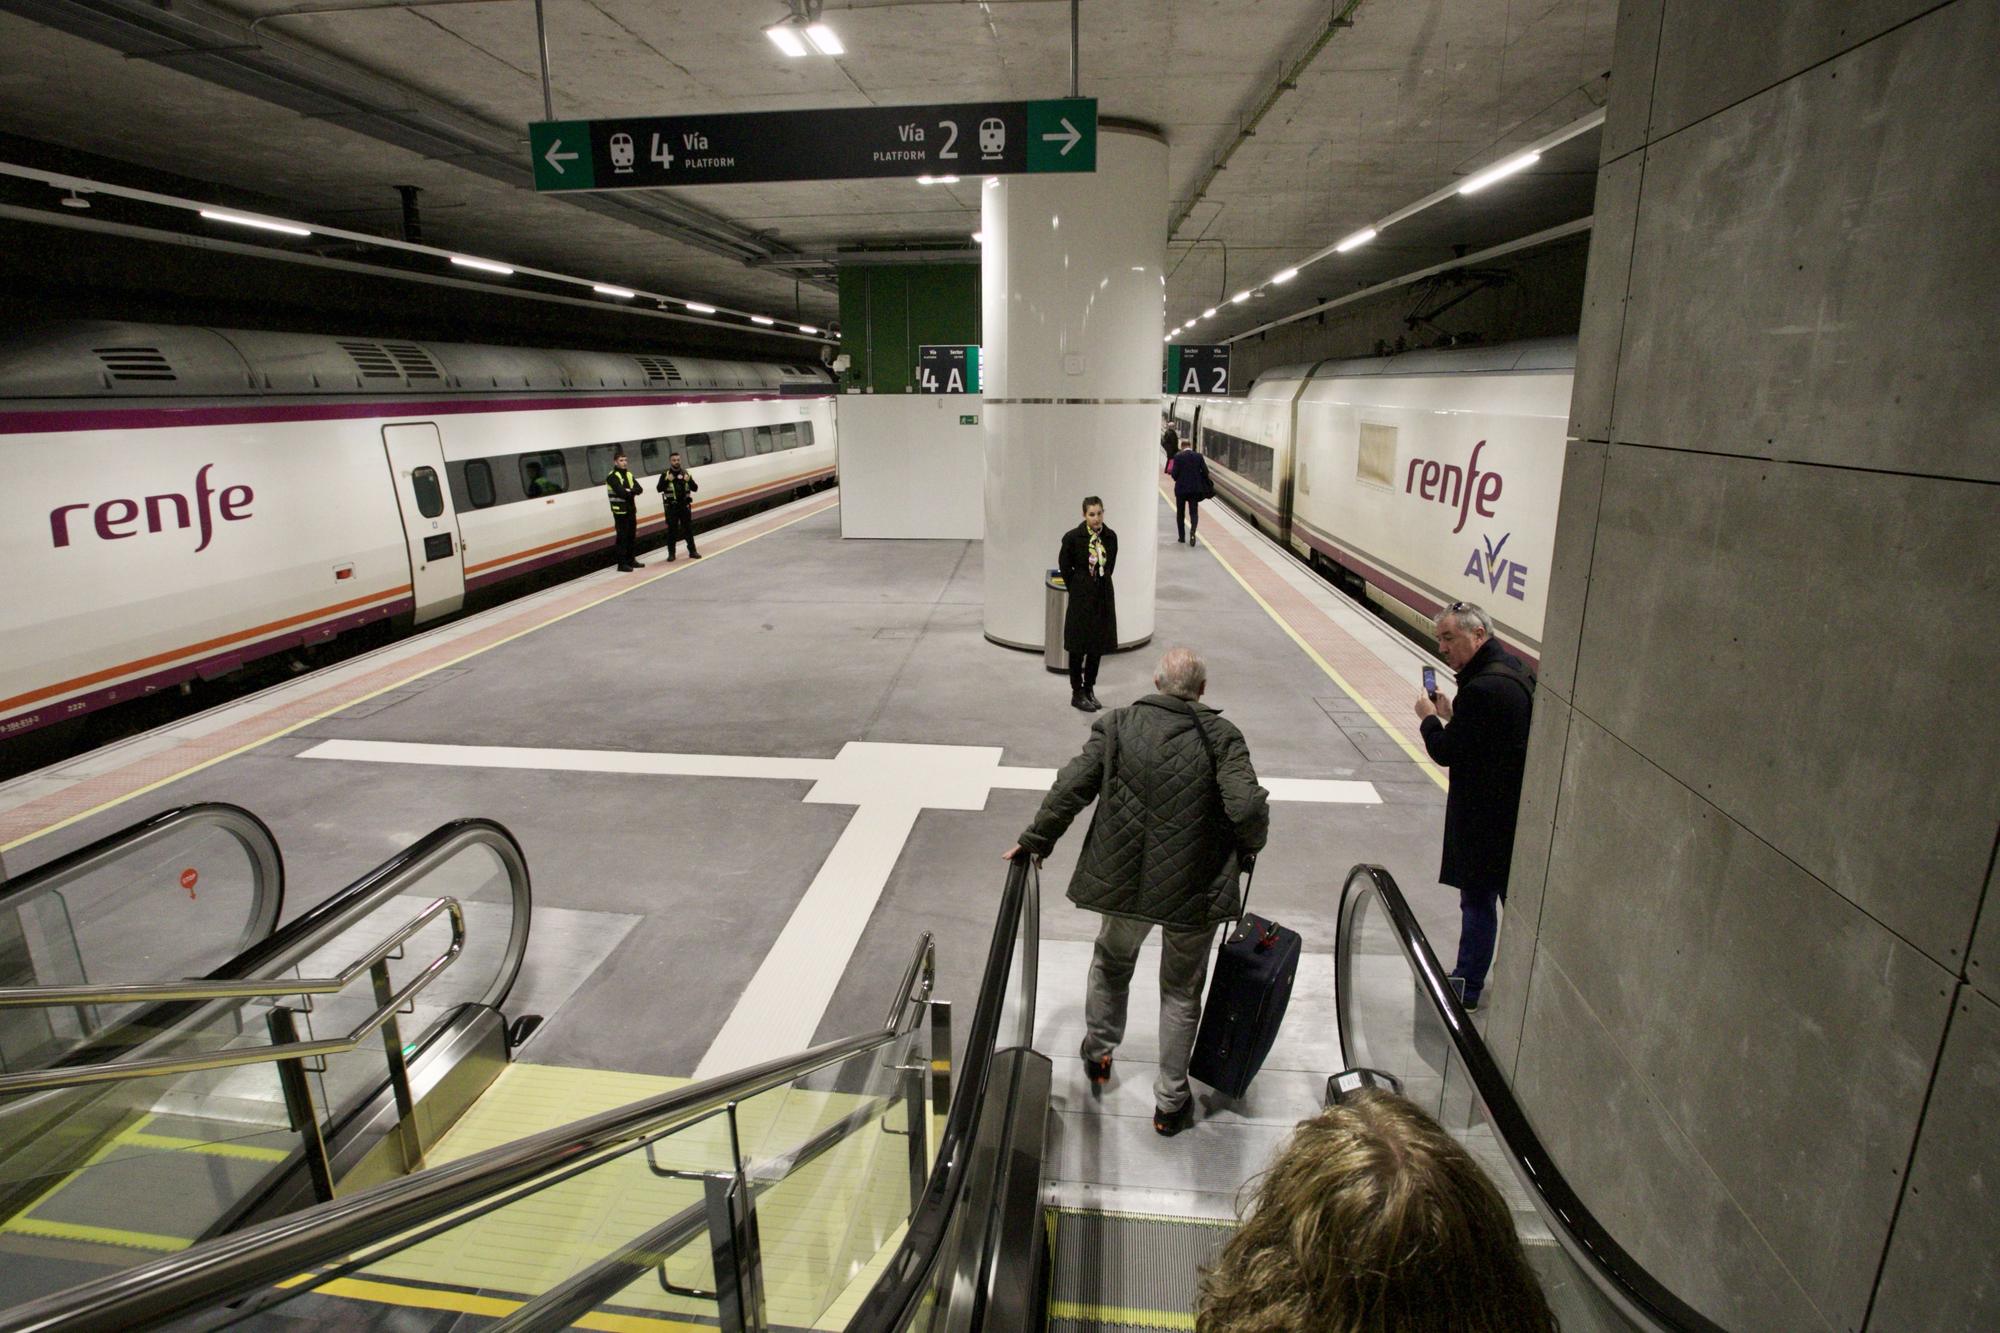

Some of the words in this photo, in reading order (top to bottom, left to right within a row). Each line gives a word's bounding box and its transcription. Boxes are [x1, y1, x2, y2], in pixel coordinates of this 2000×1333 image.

[650, 133, 674, 169] 4
[683, 132, 709, 150] Vía
[873, 150, 926, 161] PLATFORM
[898, 123, 925, 142] Vía
[938, 120, 958, 159] 2
[685, 157, 735, 168] PLATFORM
[922, 368, 939, 393] 4
[946, 368, 964, 393] A
[1182, 367, 1201, 393] A
[1211, 367, 1227, 393] 2
[1405, 440, 1503, 534] renfe
[49, 463, 254, 553] renfe
[1463, 532, 1528, 601] AVE
